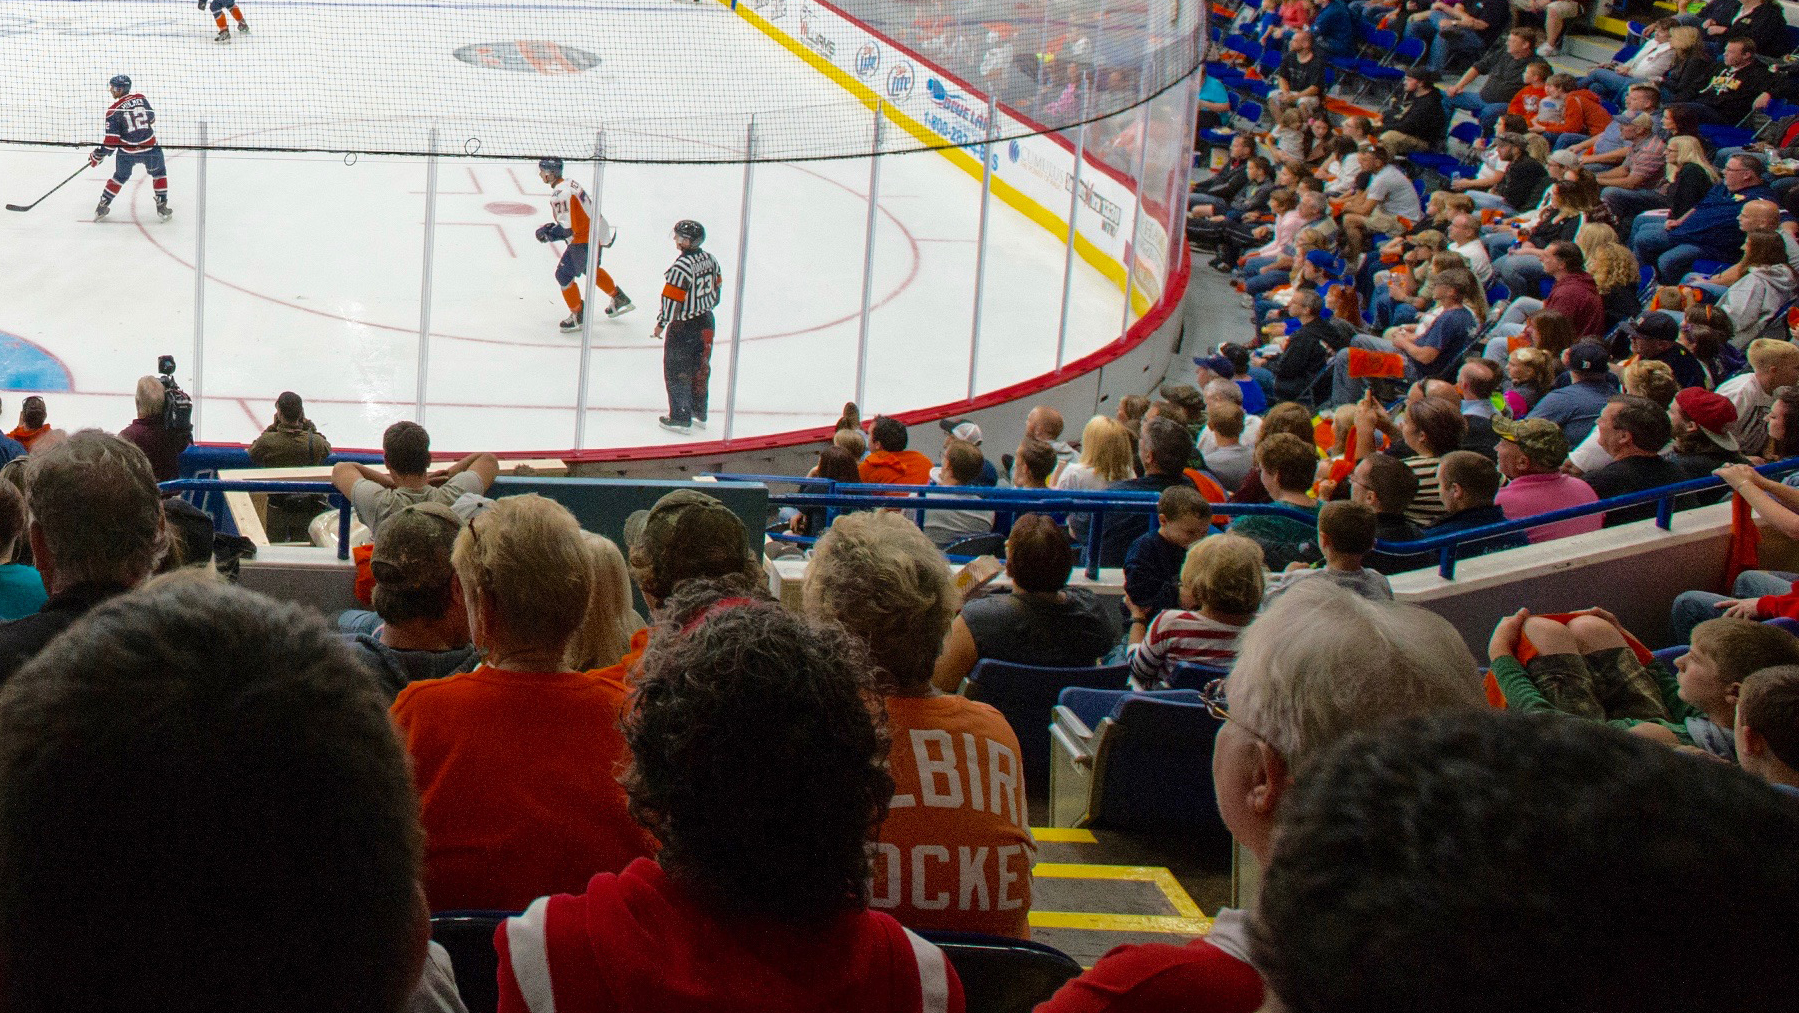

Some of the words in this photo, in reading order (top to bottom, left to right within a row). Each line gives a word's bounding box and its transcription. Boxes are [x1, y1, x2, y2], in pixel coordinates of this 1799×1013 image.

[890, 77, 911, 98] Lite
[122, 106, 150, 133] 12
[696, 274, 713, 298] 23
[889, 728, 1030, 833] BIR
[865, 842, 1034, 912] OCKE
